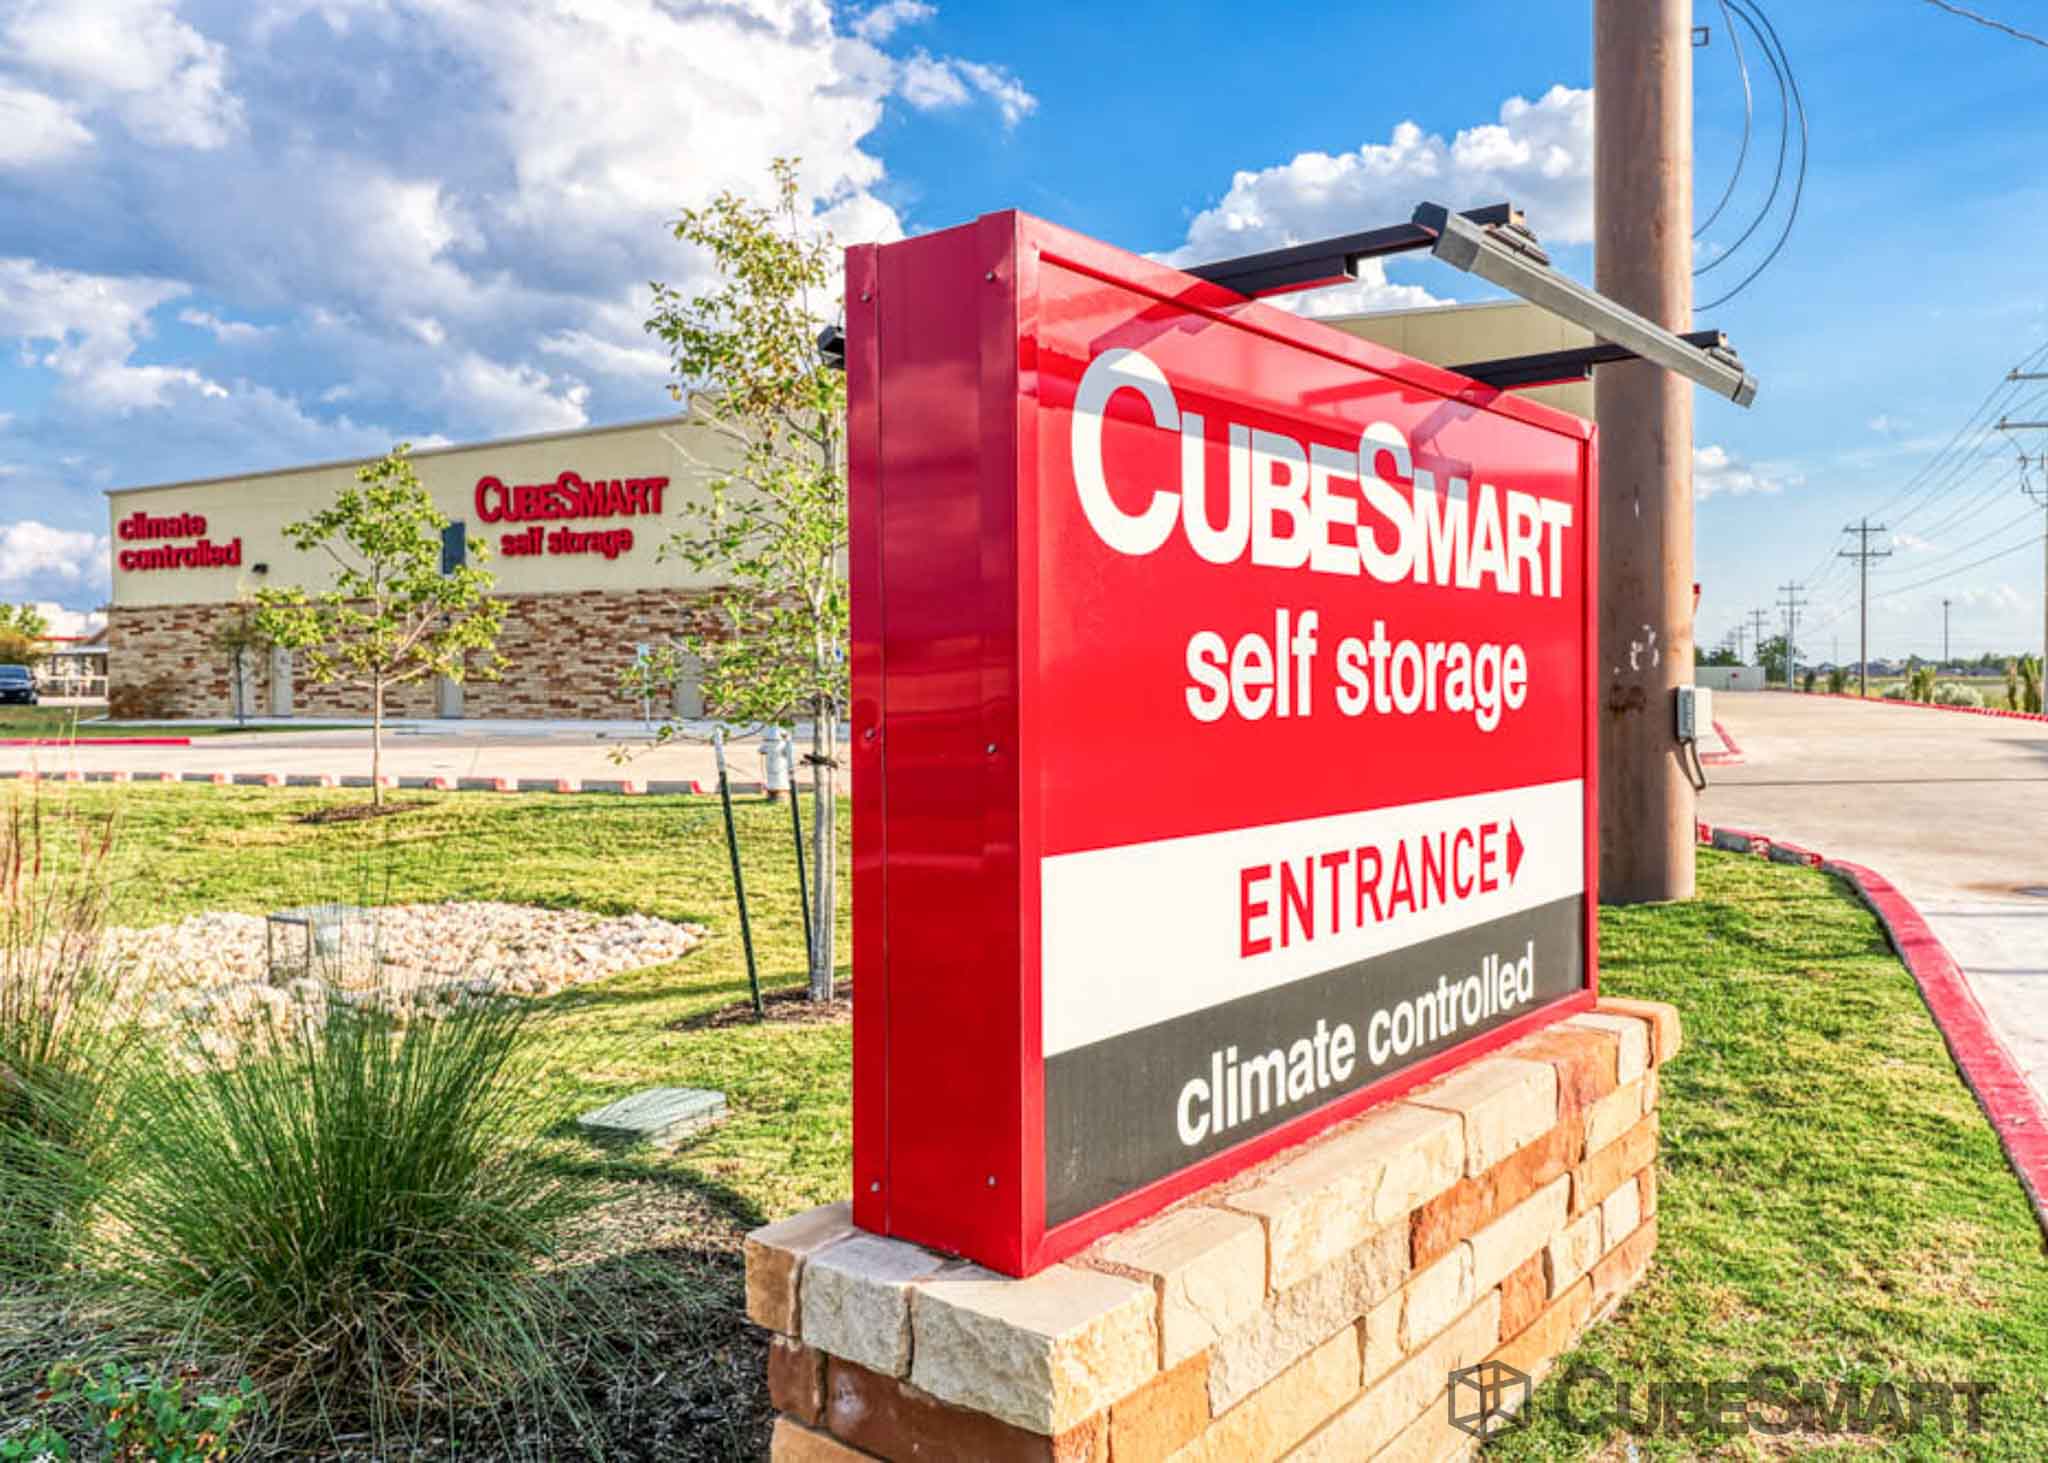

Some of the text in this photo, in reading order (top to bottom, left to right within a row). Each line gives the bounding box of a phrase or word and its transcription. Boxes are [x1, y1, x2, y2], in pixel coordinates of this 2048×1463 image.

[118, 512, 207, 540] climate
[118, 538, 242, 571] controlled
[500, 526, 633, 560] self storage
[1185, 608, 1528, 732] self storage
[1240, 821, 1499, 959] ENTRANCE
[1176, 941, 1535, 1147] climate controlled
